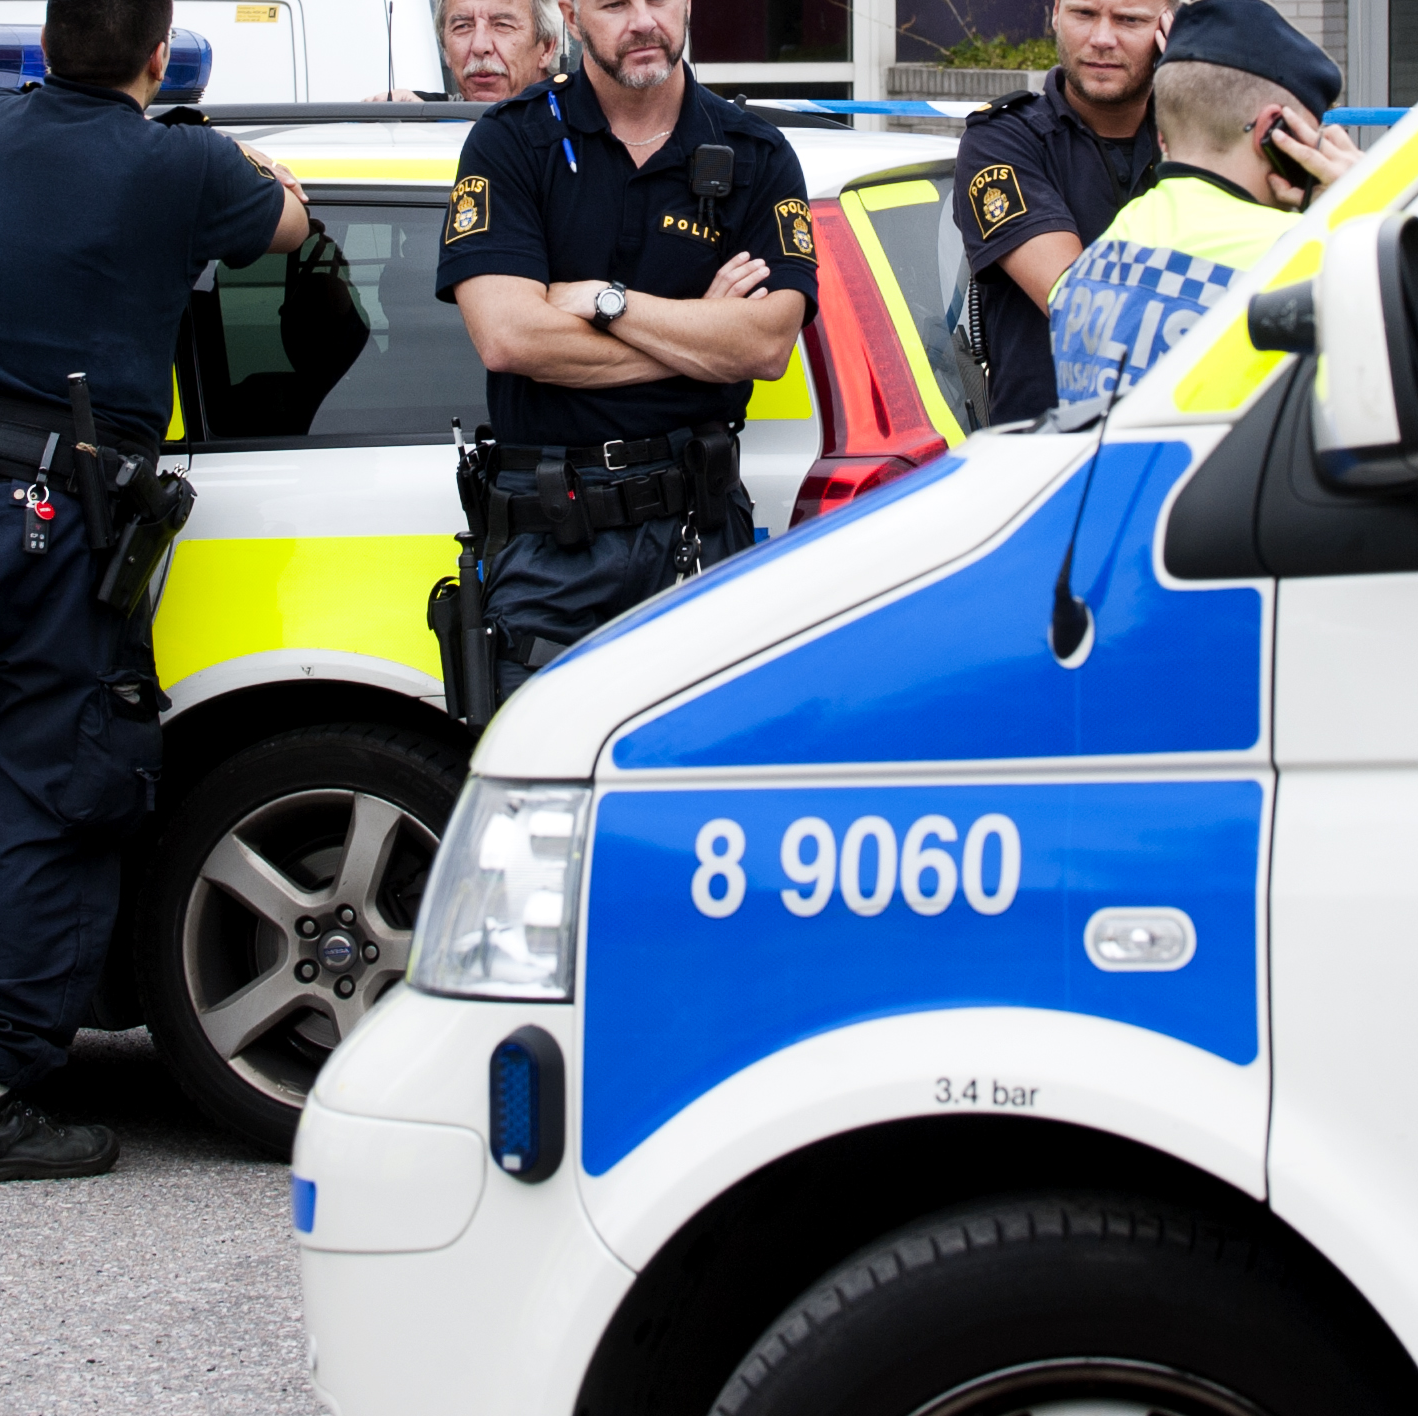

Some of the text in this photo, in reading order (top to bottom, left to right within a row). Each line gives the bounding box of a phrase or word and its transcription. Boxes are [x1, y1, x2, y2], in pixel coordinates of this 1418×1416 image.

[452, 179, 485, 203] POLIS
[971, 168, 1009, 197] POLIS
[691, 813, 1021, 919] 8 9060
[935, 1077, 1040, 1106] 3.4 bar
